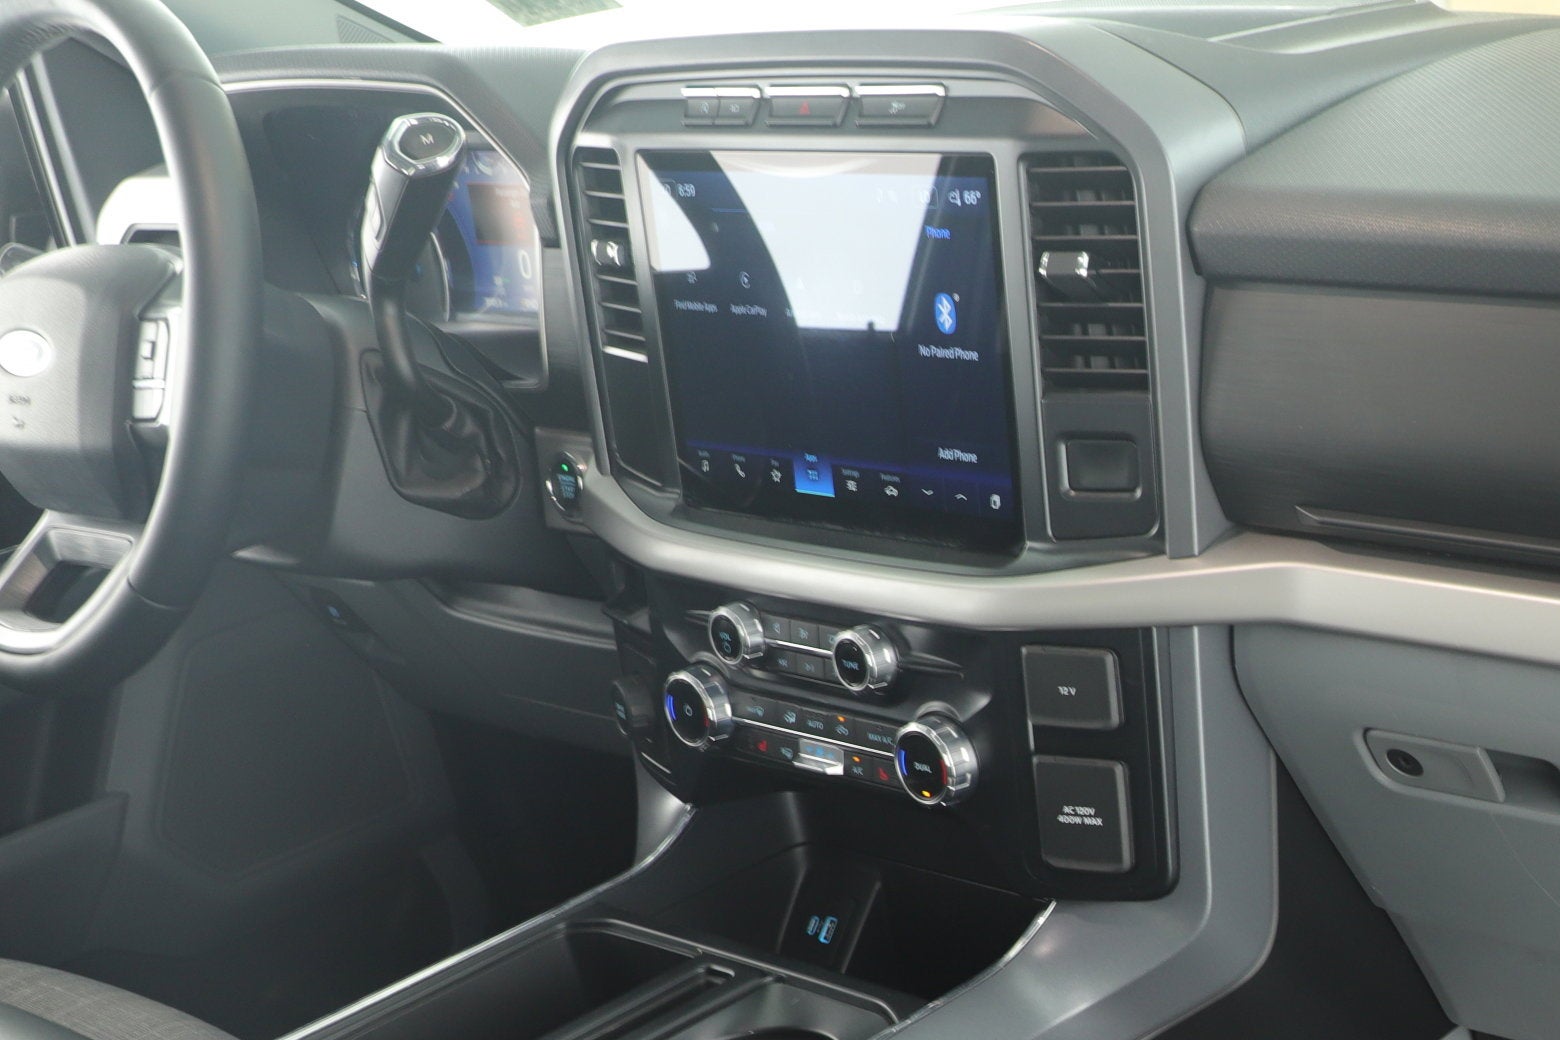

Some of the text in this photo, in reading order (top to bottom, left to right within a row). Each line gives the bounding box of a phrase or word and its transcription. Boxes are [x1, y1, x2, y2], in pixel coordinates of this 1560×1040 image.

[419, 133, 434, 145] M
[925, 225, 951, 240] Phone
[918, 344, 979, 361] No Paired Phone
[938, 447, 978, 463] Add Phone
[807, 719, 825, 731] AUTO
[1063, 805, 1095, 816] AC 120V
[1083, 816, 1103, 827] MAX
